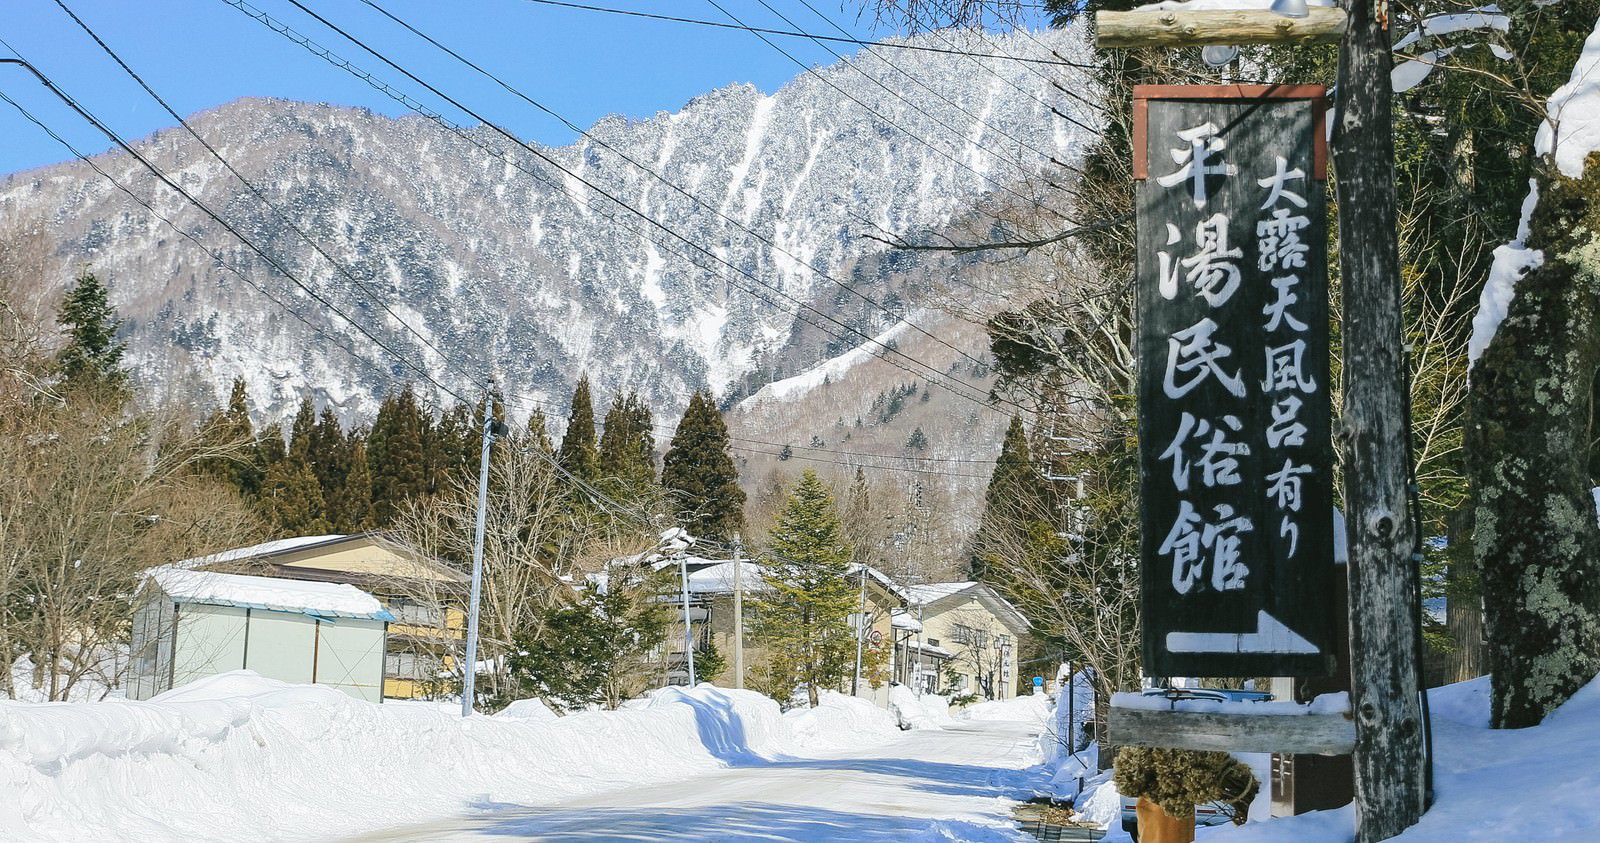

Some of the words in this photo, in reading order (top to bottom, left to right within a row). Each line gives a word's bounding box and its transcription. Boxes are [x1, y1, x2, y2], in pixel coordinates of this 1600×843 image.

[1156, 121, 1254, 595] 平湯民俗館
[1256, 155, 1317, 559] 大露天風呂有り
